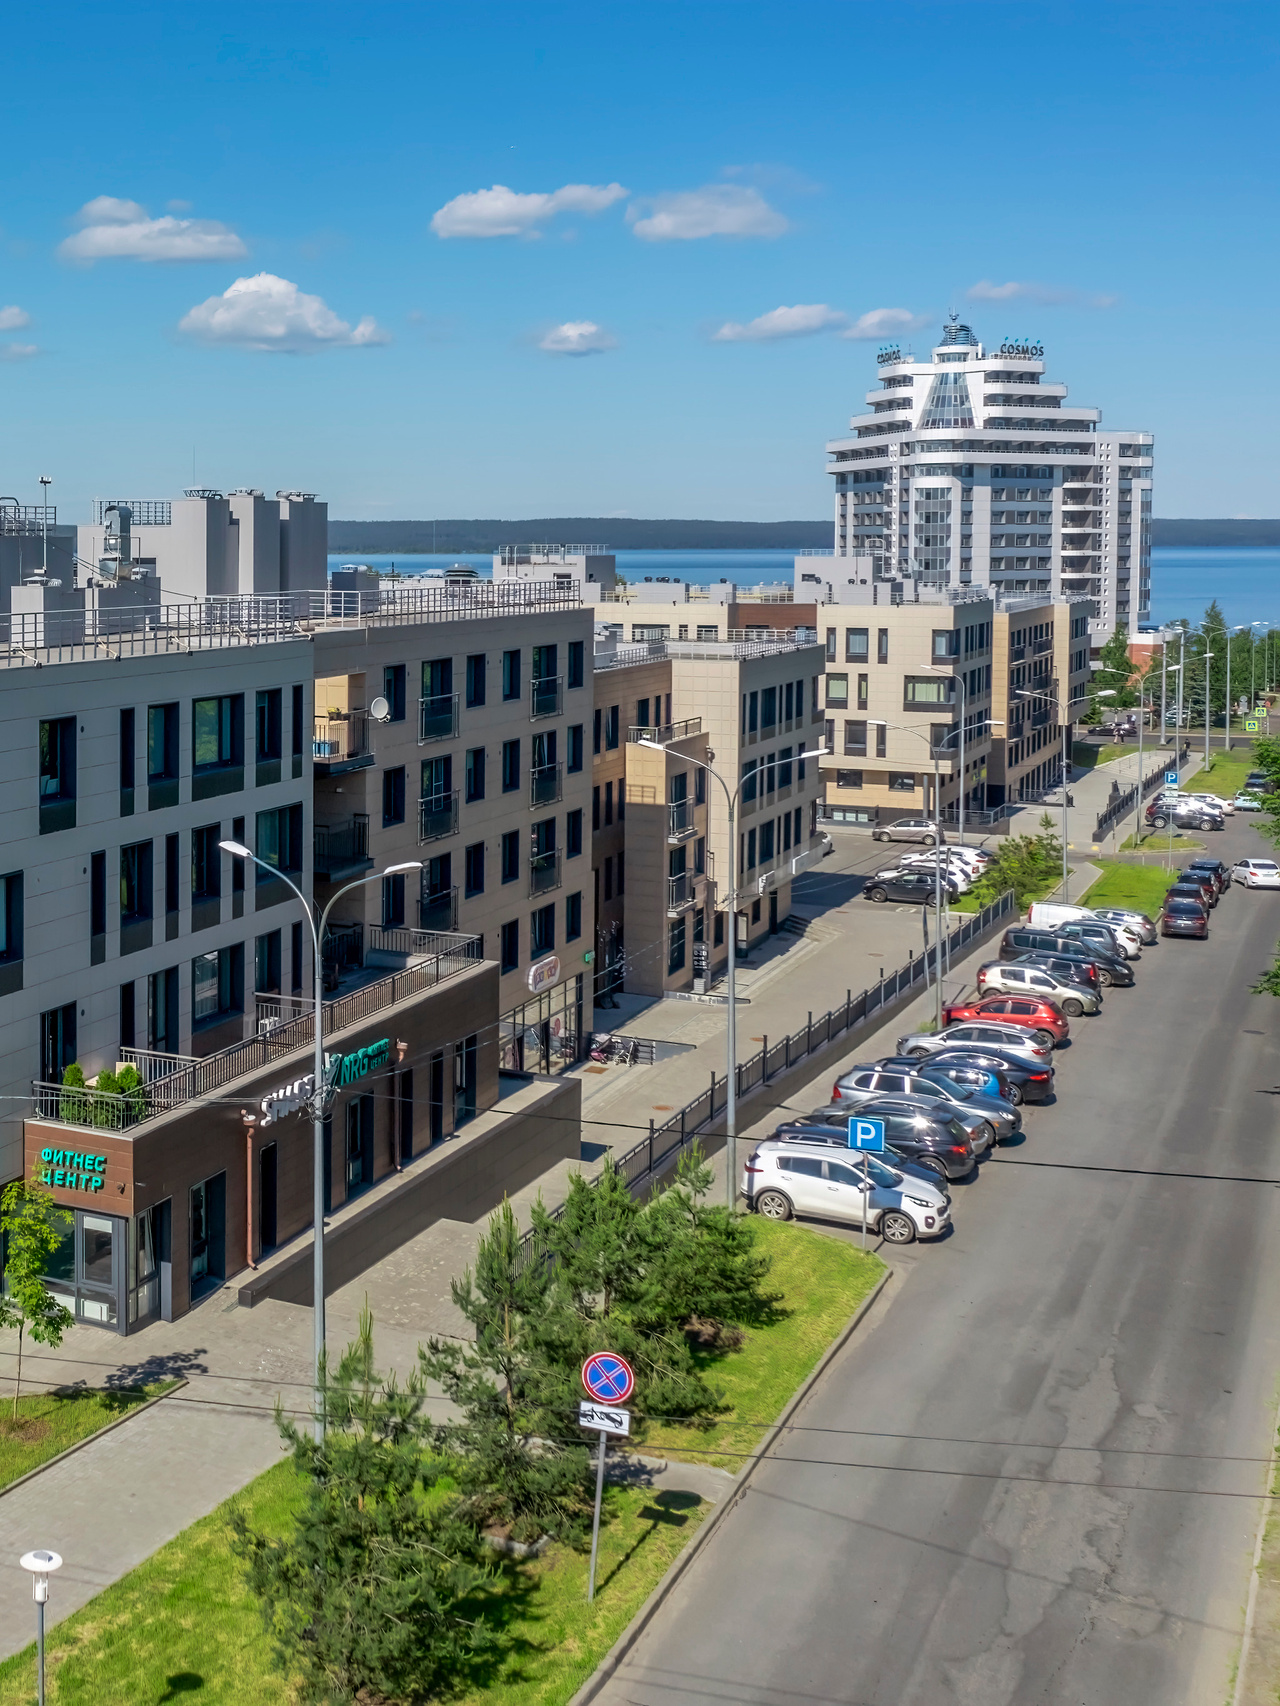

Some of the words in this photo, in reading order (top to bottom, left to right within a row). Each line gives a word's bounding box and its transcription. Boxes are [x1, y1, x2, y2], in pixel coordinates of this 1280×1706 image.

[876, 349, 901, 364] COSMOS
[999, 343, 1044, 357] COSMOS
[1168, 773, 1176, 782] P
[342, 1048, 369, 1085] NRG
[856, 1122, 876, 1147] P
[41, 1147, 105, 1172] ФИТНЕС
[42, 1168, 102, 1191] ЦЕНТР
